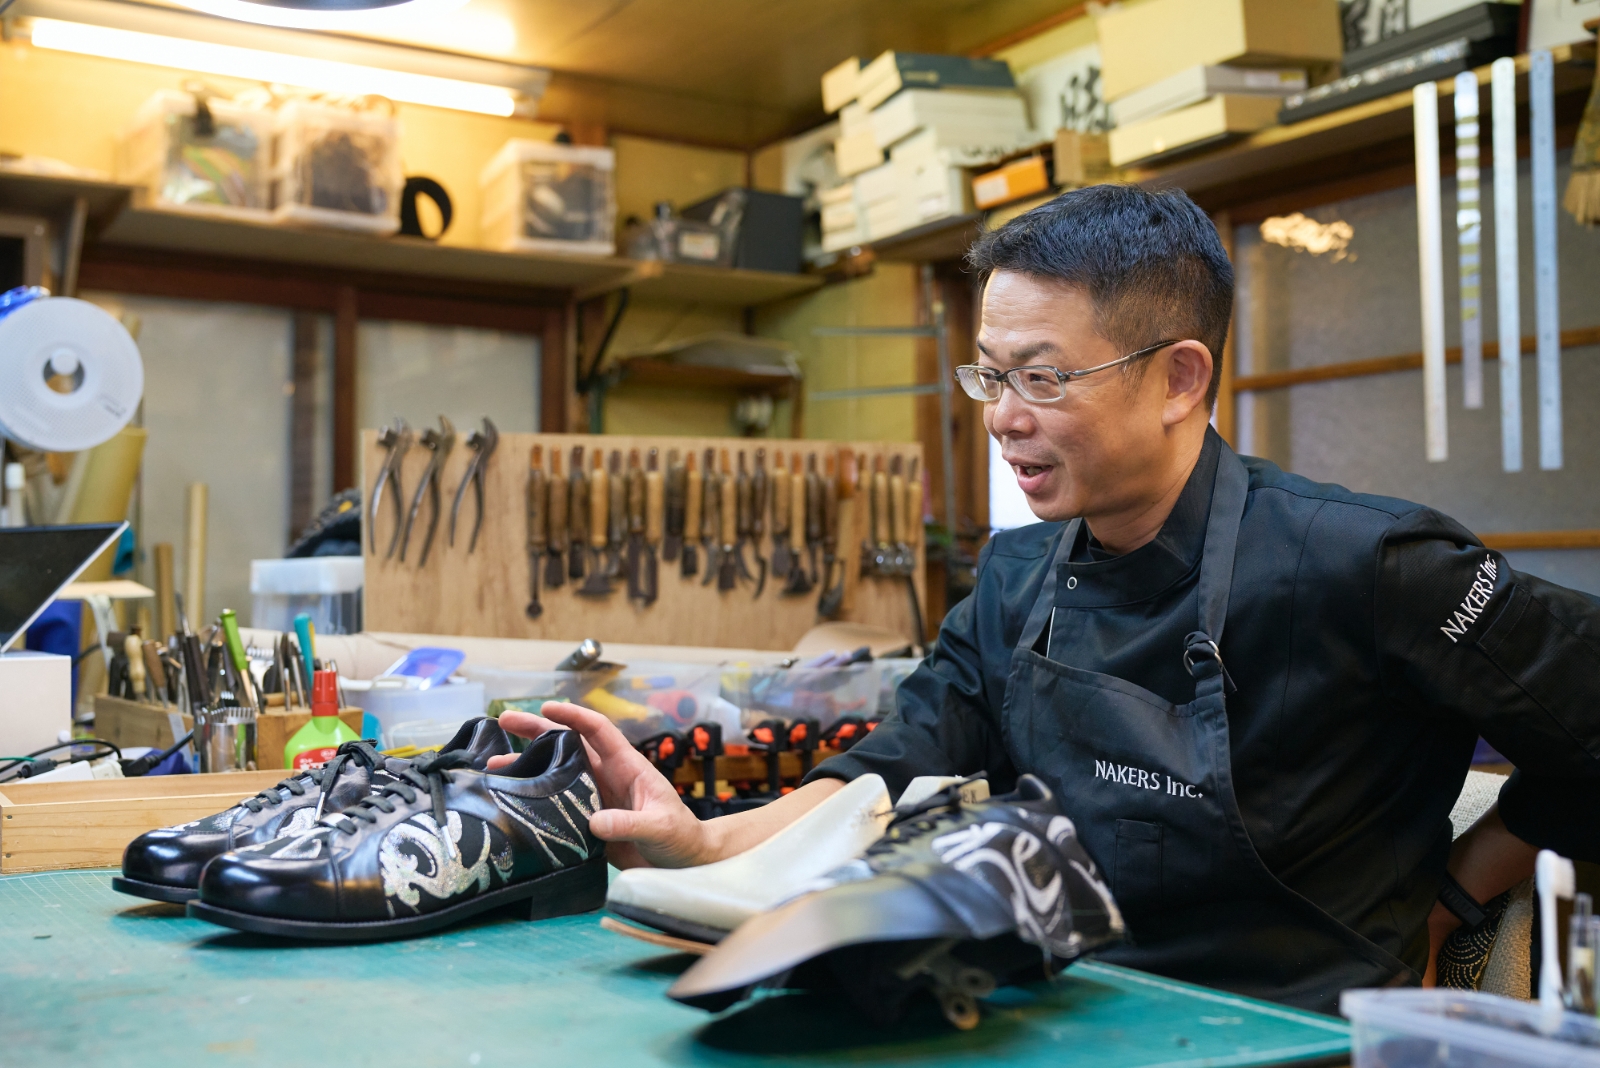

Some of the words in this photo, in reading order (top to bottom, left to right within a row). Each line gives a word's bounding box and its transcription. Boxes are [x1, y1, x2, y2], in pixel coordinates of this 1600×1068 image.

[1440, 571, 1494, 643] NAKERS
[1095, 759, 1160, 790] NAKERS
[1166, 775, 1204, 799] Inc.
